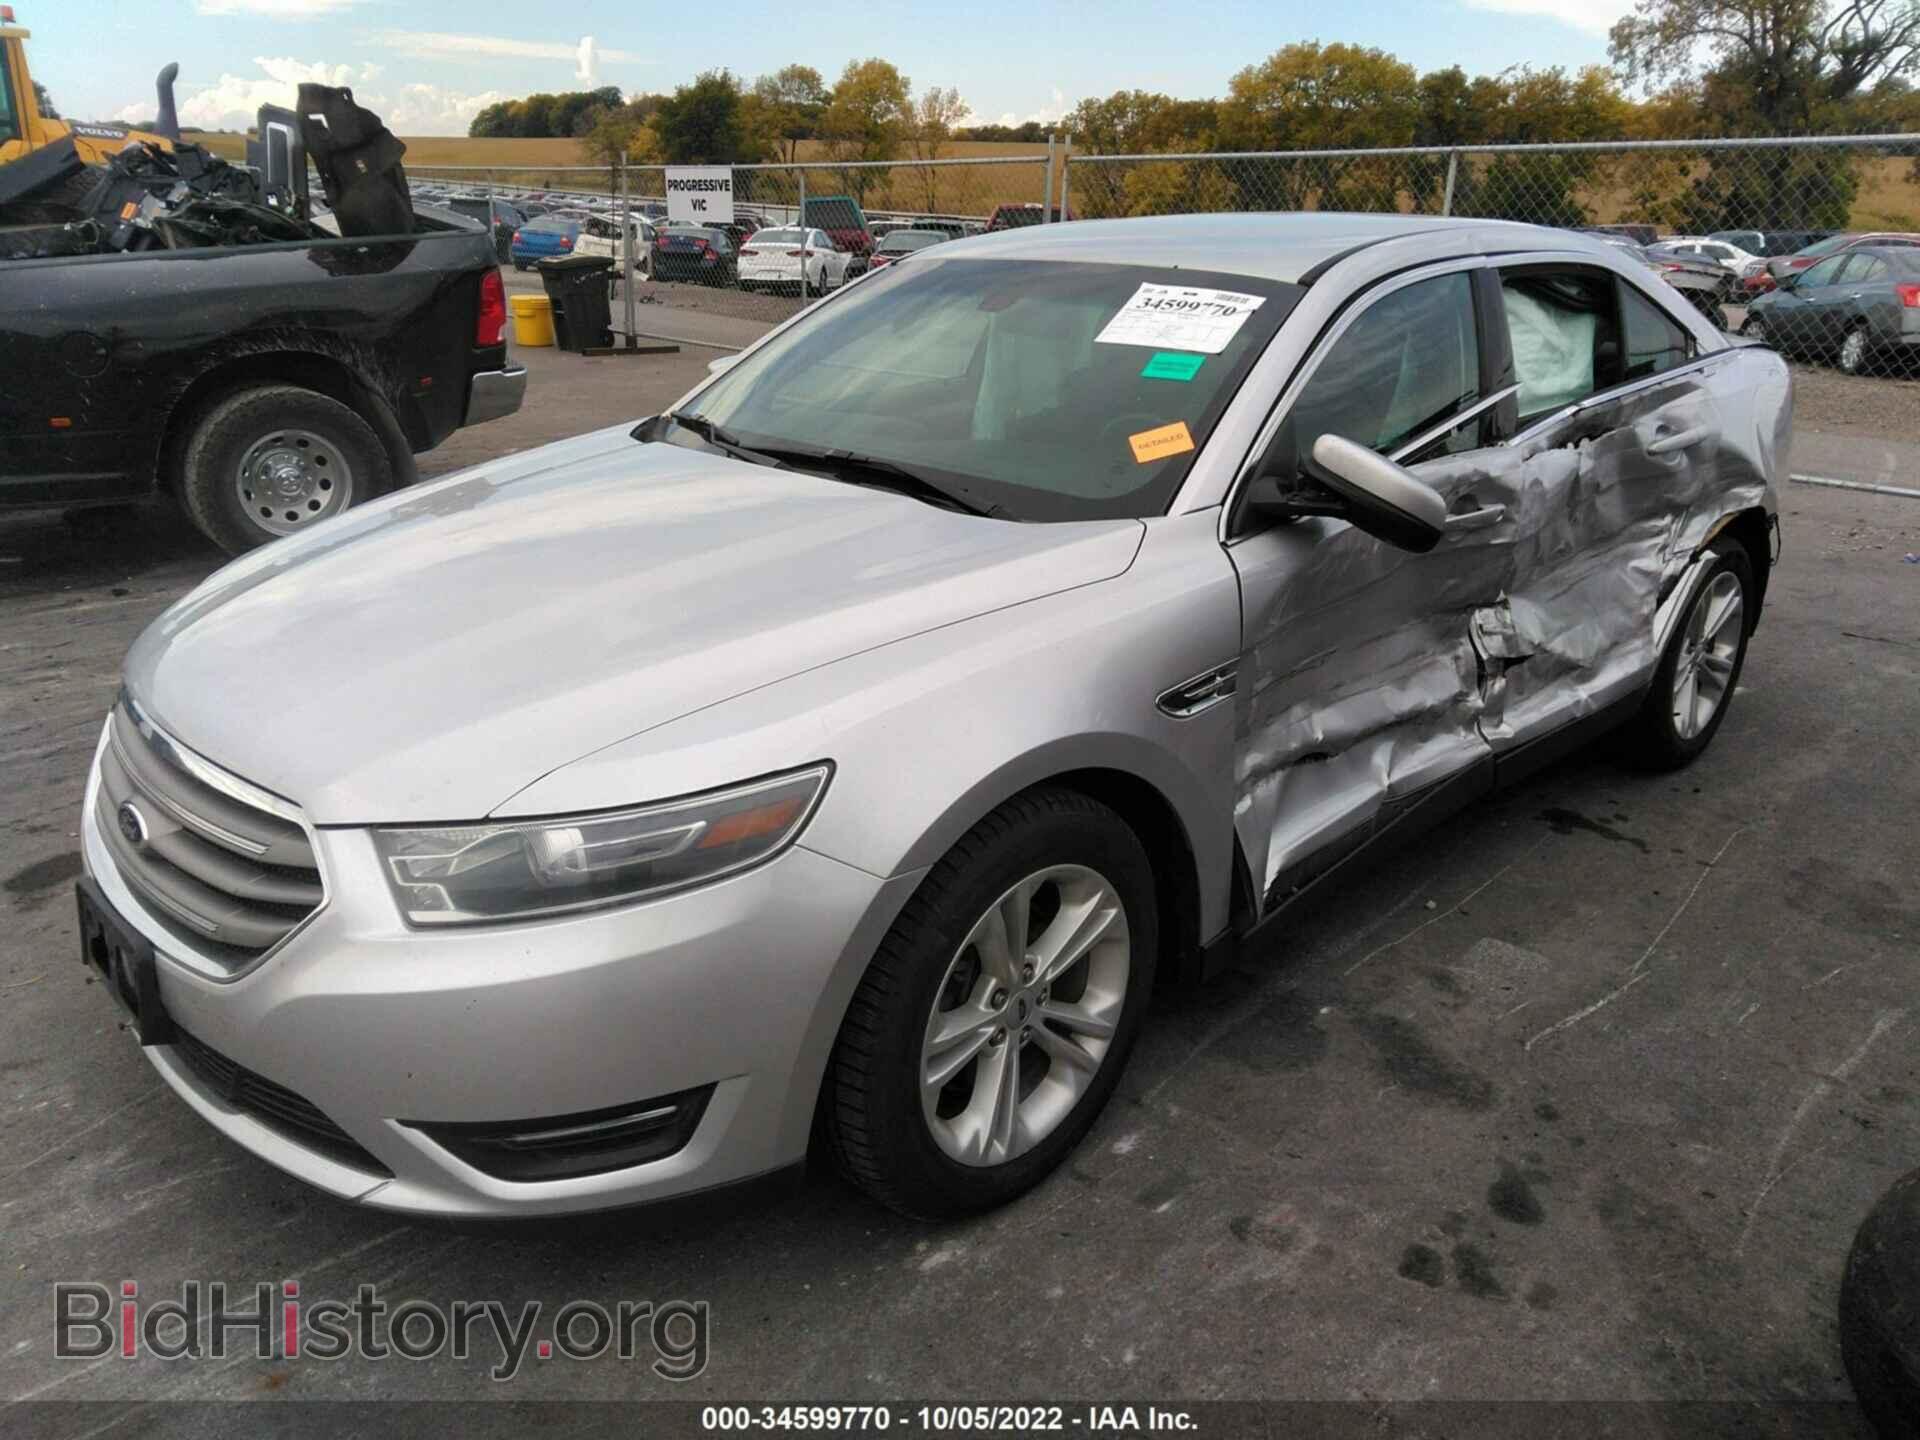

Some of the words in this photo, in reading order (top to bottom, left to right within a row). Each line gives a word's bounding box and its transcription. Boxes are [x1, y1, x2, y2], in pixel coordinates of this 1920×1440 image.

[74, 126, 124, 138] VOLVO
[667, 179, 731, 192] PROGRESSIVE
[691, 198, 707, 211] VIC
